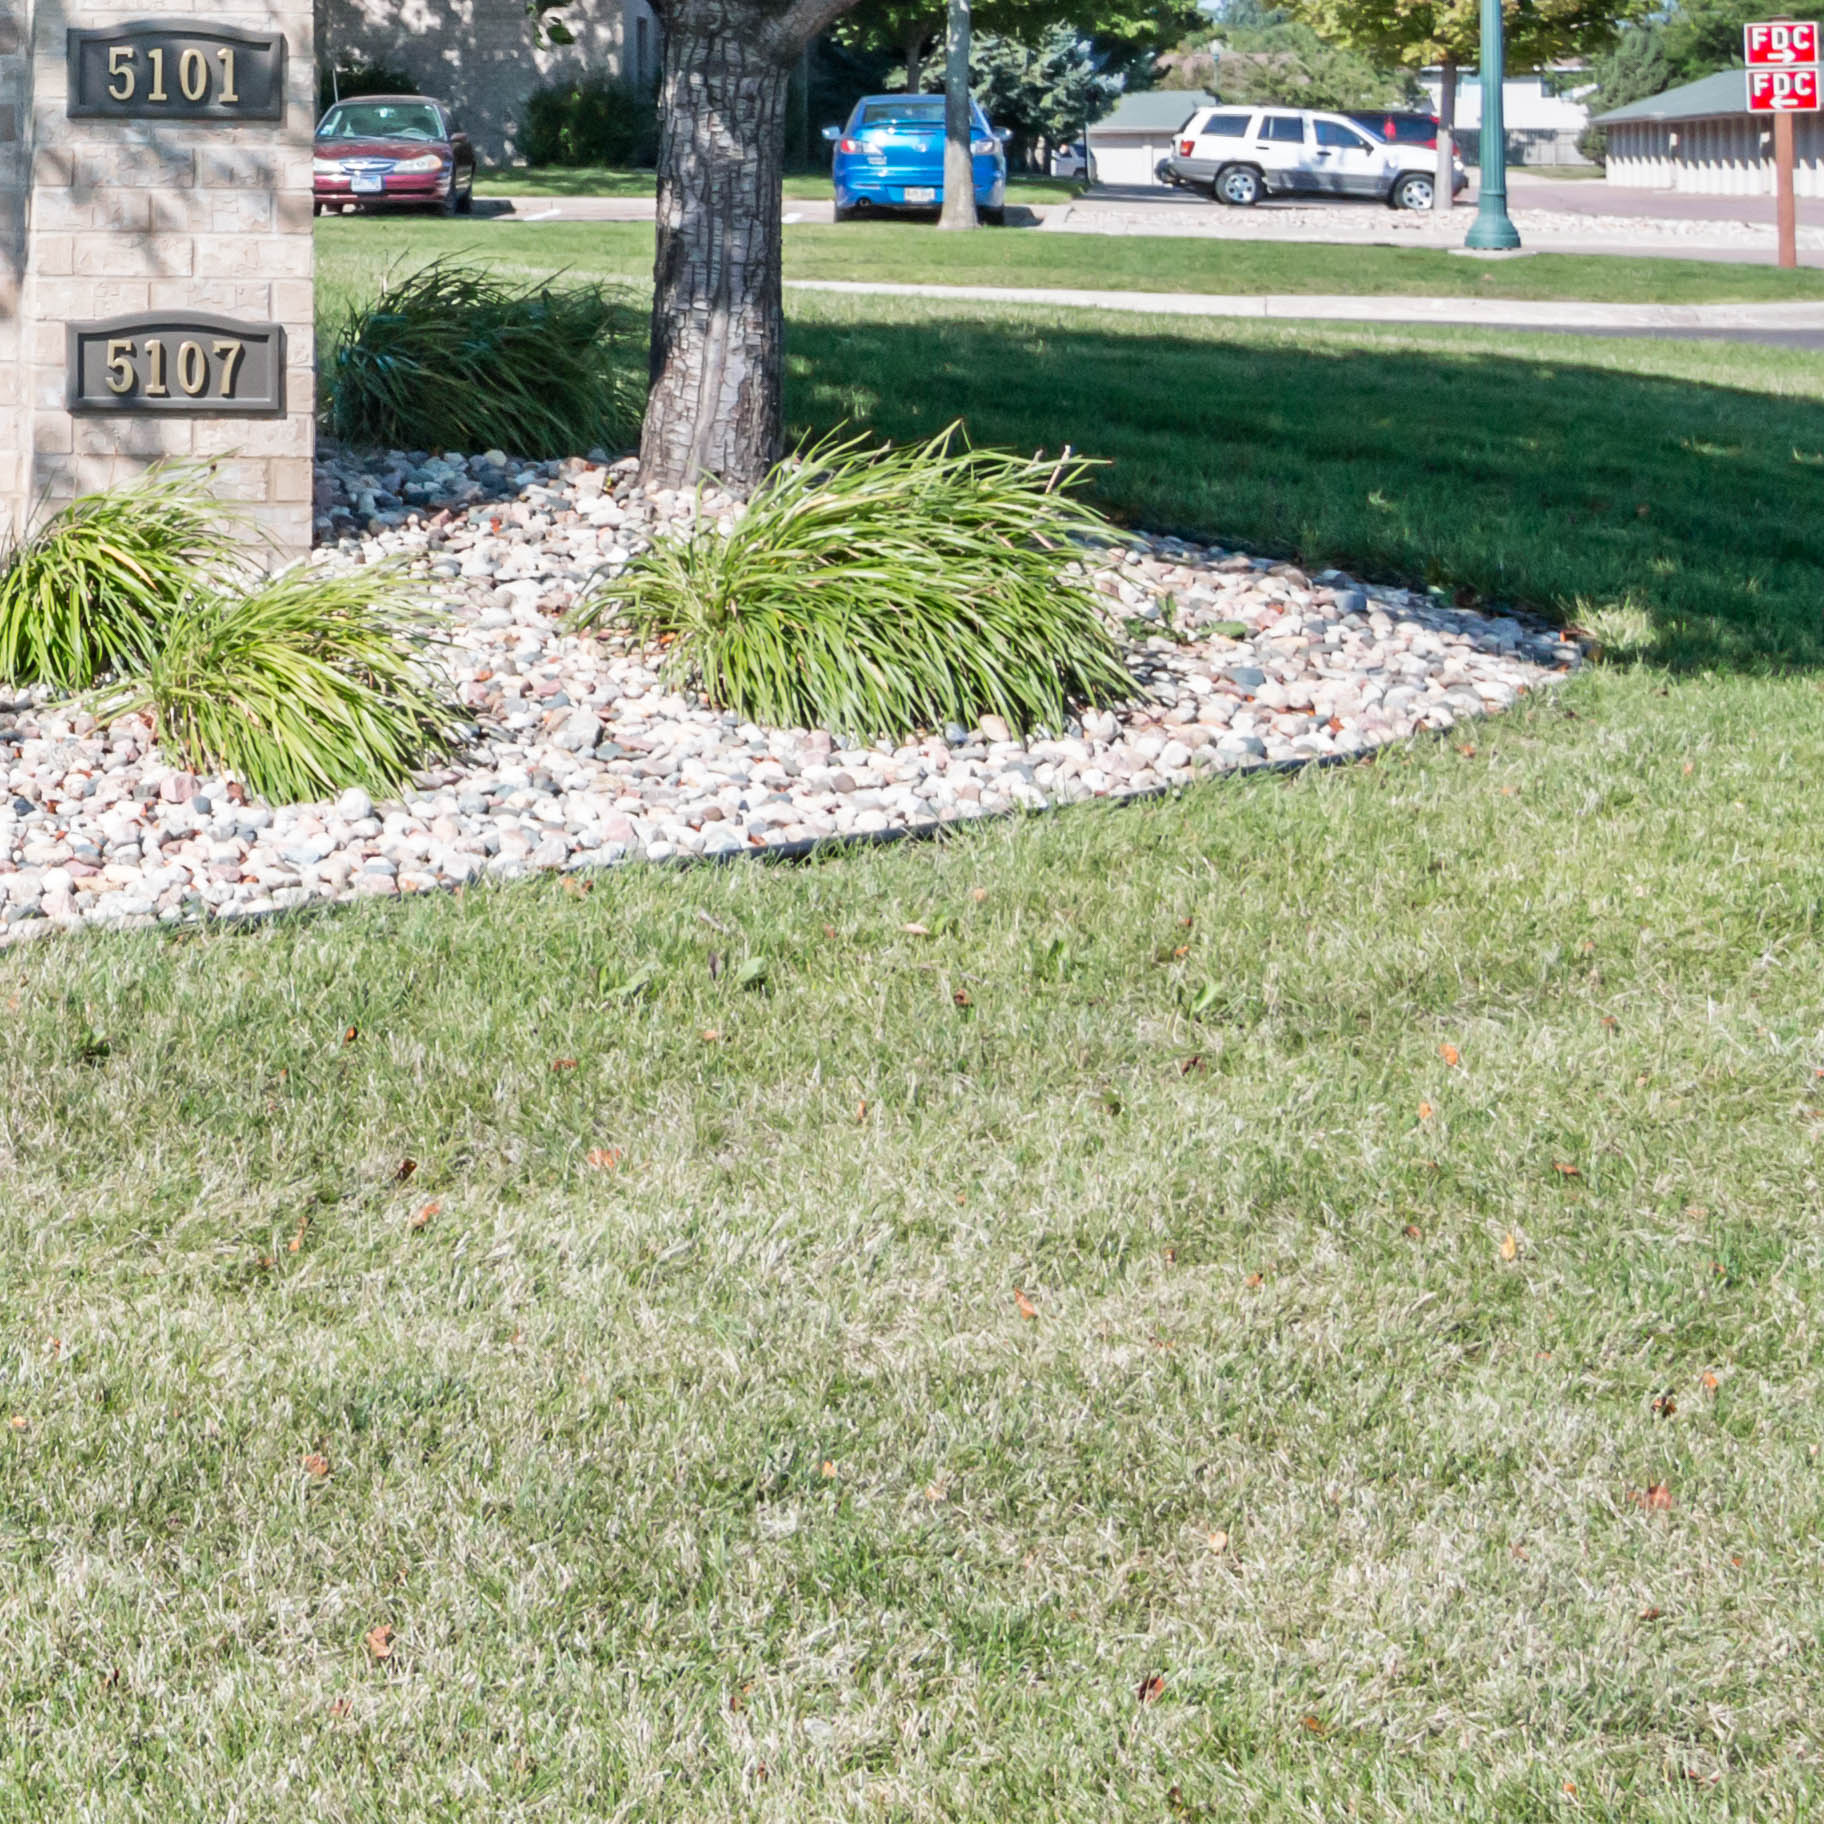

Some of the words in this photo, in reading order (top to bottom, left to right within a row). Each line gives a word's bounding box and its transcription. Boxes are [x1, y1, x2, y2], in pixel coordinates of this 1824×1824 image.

[1752, 26, 1811, 50] FDC
[109, 45, 239, 102] 5101
[1753, 72, 1812, 96] FDC
[105, 339, 241, 394] 5107
